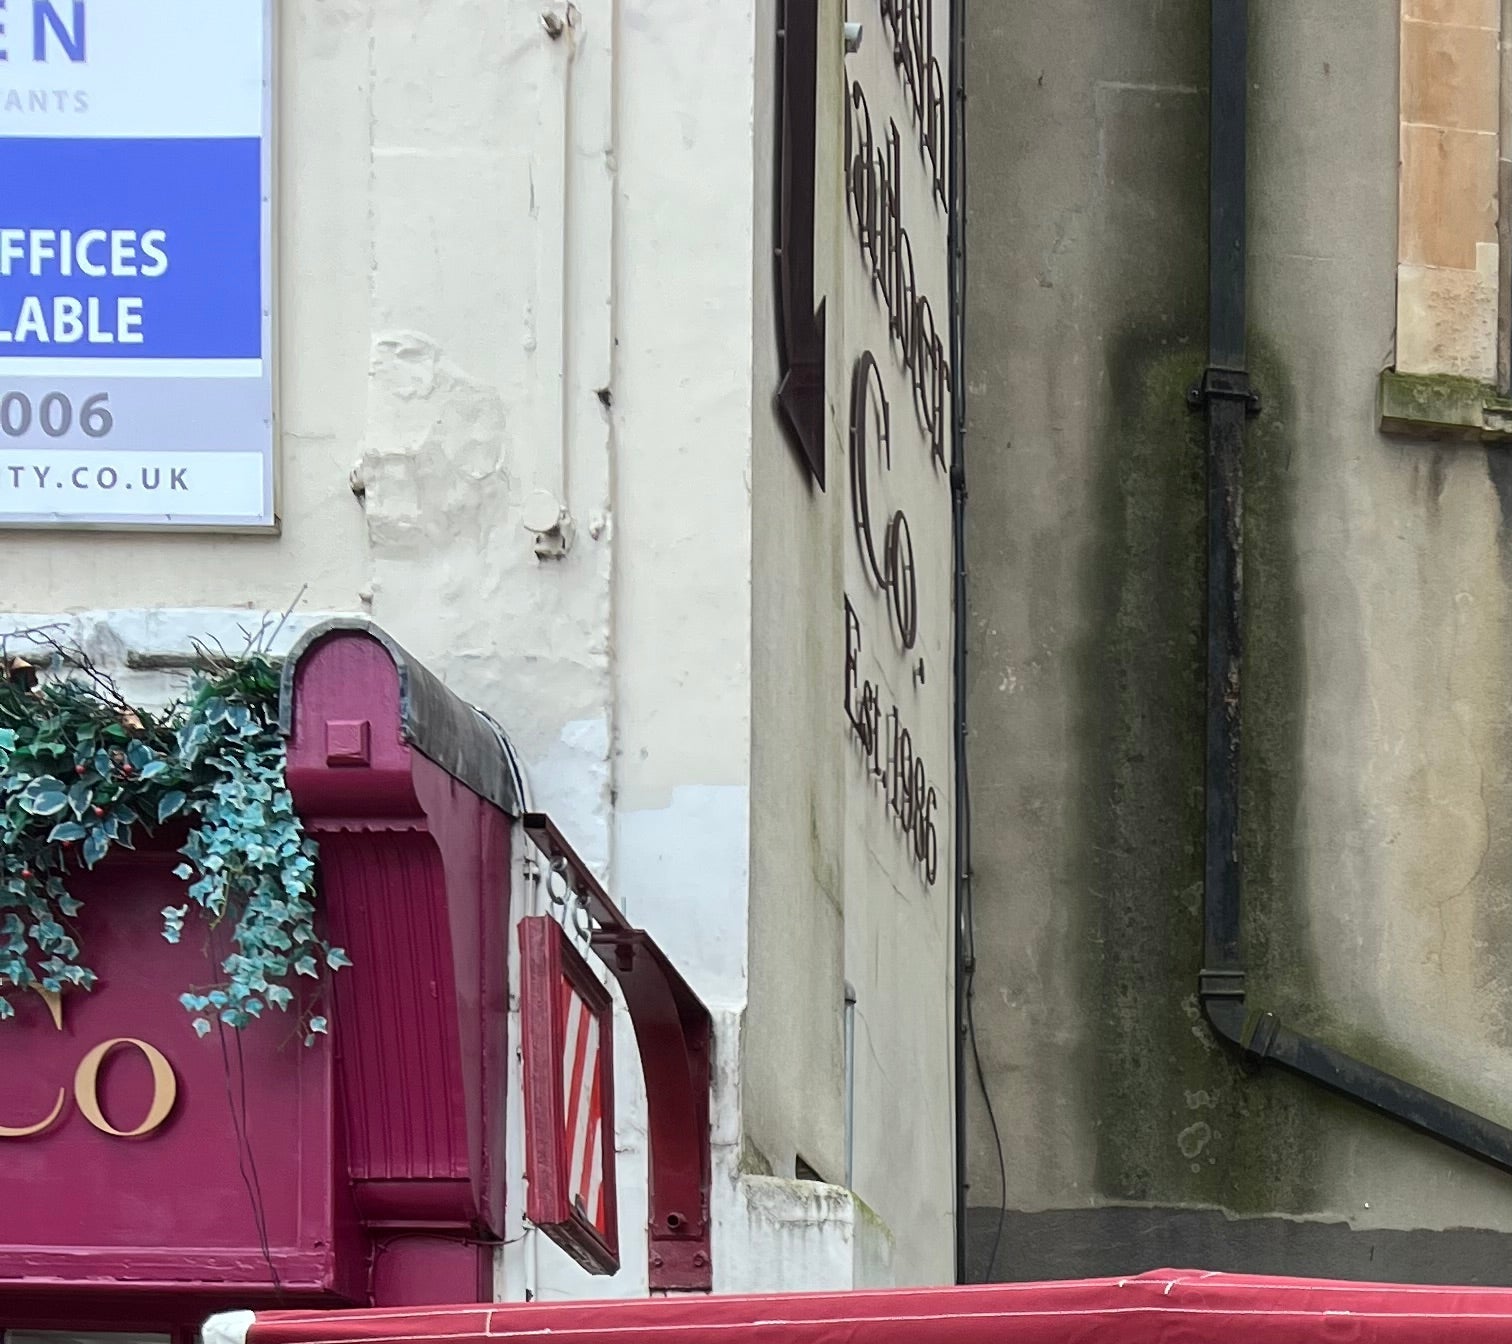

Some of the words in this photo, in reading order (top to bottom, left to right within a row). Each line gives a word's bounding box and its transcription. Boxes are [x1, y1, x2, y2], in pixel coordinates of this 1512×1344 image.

[0, 0, 85, 61] N
[1, 391, 114, 437] 006
[8, 465, 189, 490] TY.CO.UK
